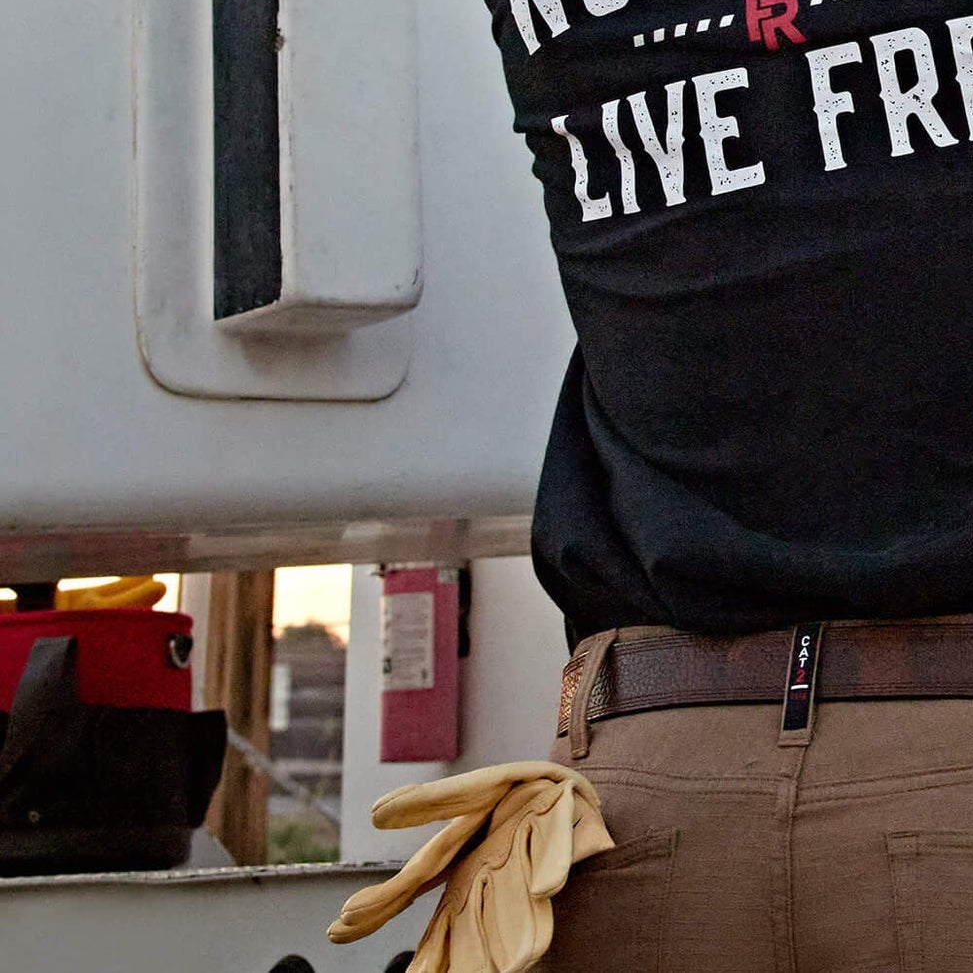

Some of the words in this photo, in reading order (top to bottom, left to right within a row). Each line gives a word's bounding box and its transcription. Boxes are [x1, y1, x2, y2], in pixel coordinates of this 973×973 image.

[551, 67, 765, 222] LIVE
[798, 635, 810, 668] CAT
[796, 668, 806, 683] 2
